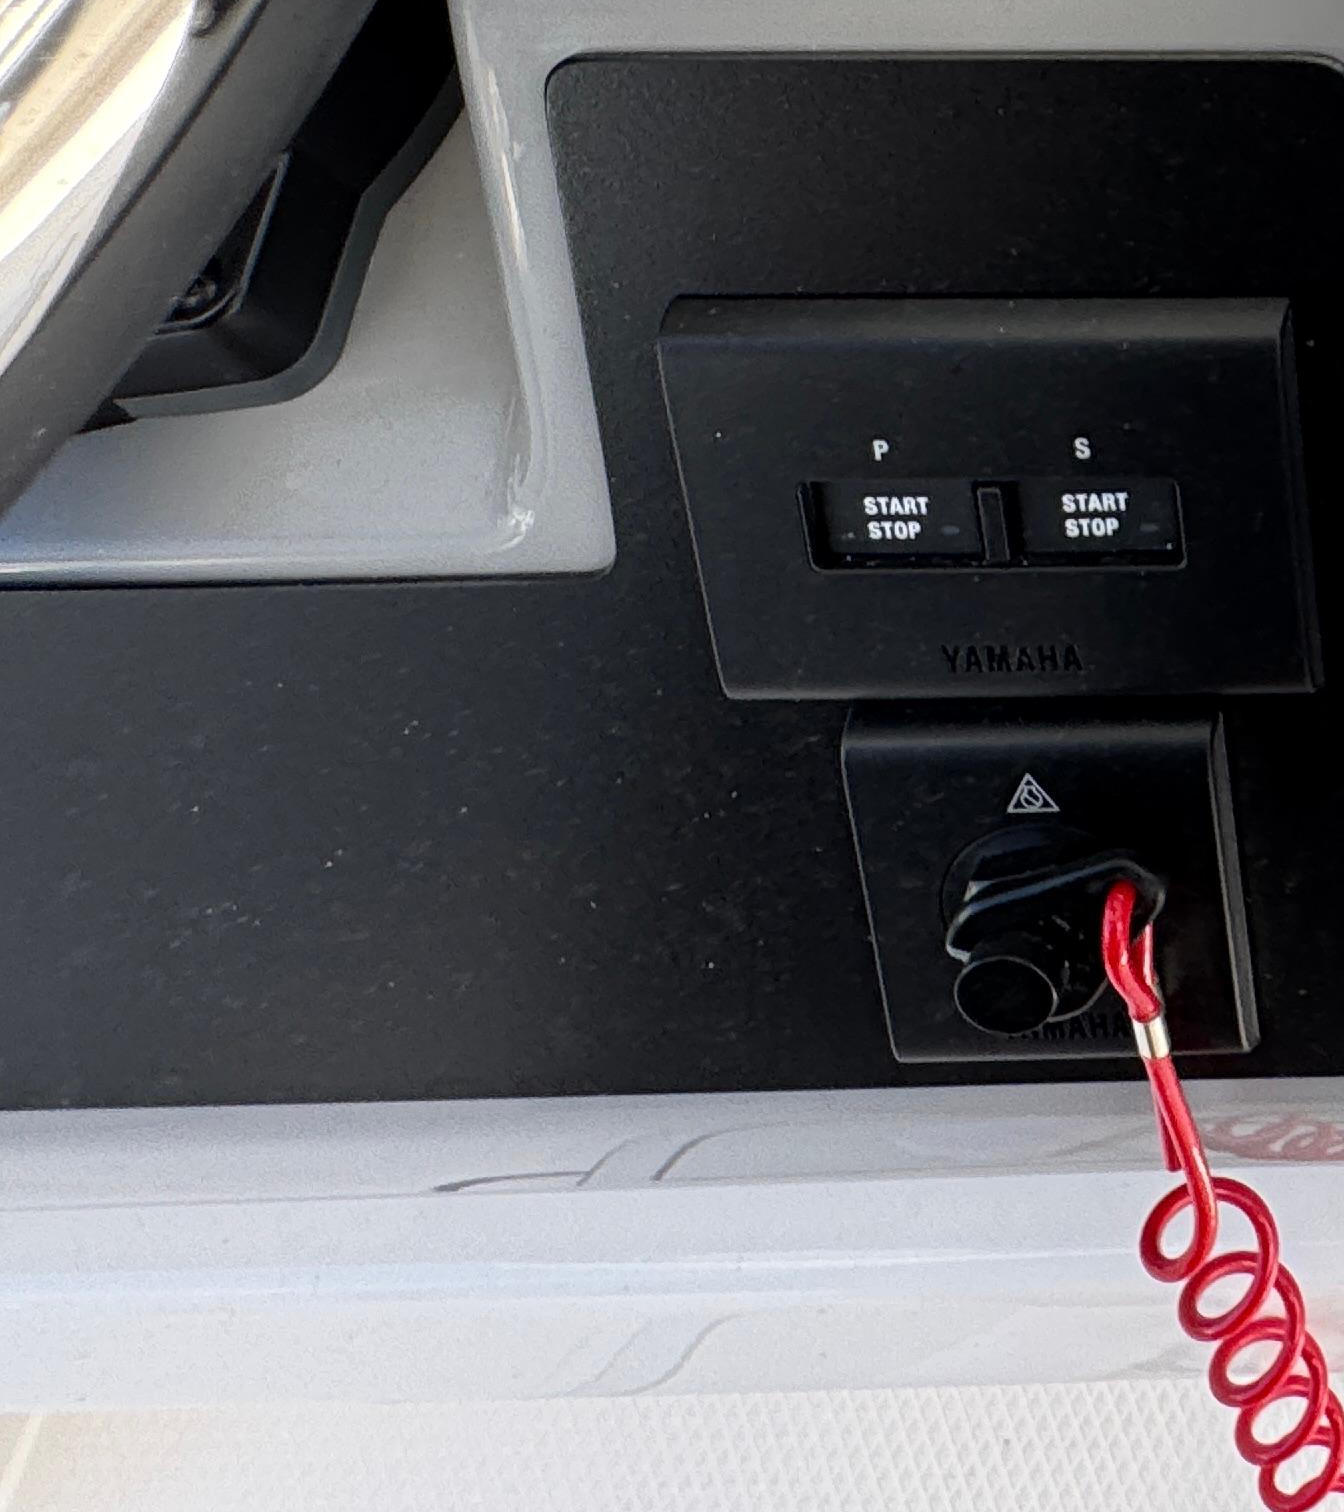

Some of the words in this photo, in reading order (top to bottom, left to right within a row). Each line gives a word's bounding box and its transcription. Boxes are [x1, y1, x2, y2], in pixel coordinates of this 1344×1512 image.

[872, 439, 890, 462] P
[1073, 437, 1092, 460] S
[863, 495, 929, 517] START
[1061, 492, 1128, 514] START
[867, 520, 922, 541] STOP
[1064, 517, 1120, 538] STOP
[940, 644, 1085, 674] YAMAHA
